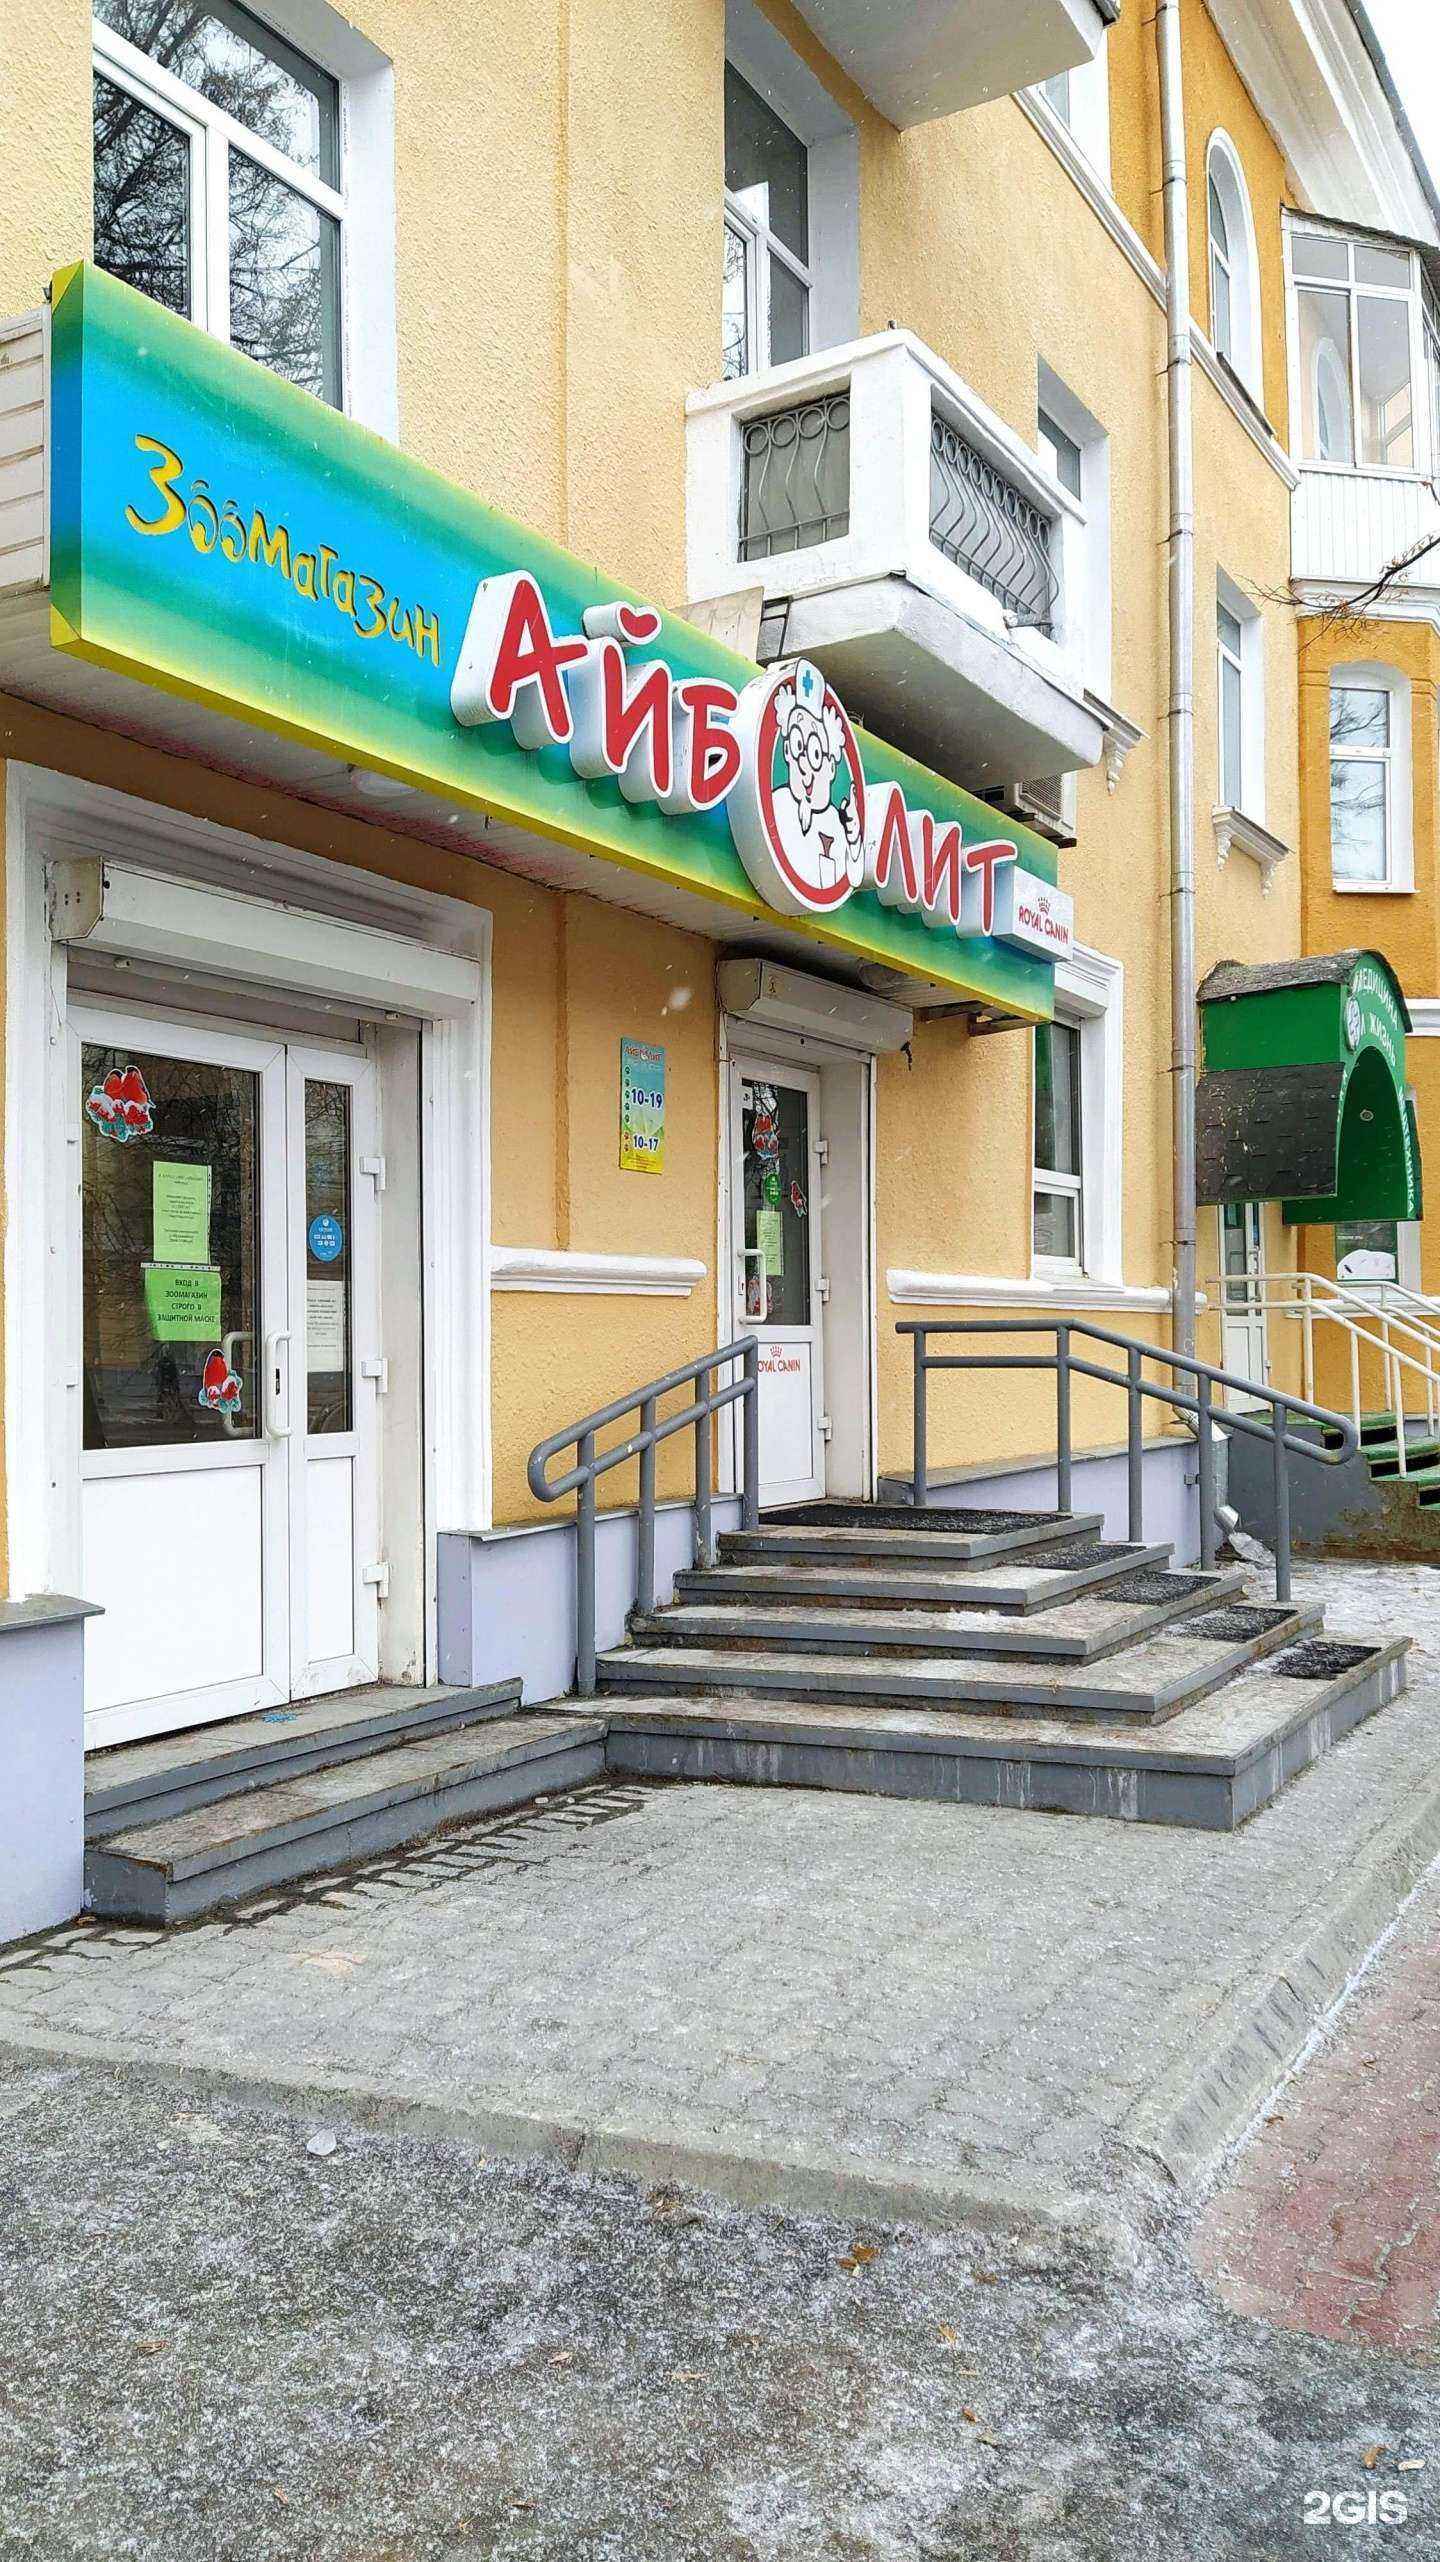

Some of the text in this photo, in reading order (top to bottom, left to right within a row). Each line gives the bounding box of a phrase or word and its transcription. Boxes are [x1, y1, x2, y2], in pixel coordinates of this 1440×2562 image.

[1018, 905, 1069, 944] ROYAL CANIN
[1352, 967, 1398, 1031] МЕДИЦИНА
[1369, 1012, 1396, 1067] ЖИЗНЬ
[631, 1088, 663, 1109] 10-19
[633, 1134, 659, 1151] 10-17
[175, 1279, 192, 1287] ВХОД
[164, 1290, 208, 1299] ЗООМАГАЗИН
[171, 1302, 195, 1310] СТРОГО
[157, 1313, 193, 1322] ЗАЩИТНОЙ
[757, 1359, 801, 1372] OYAL CANIN
